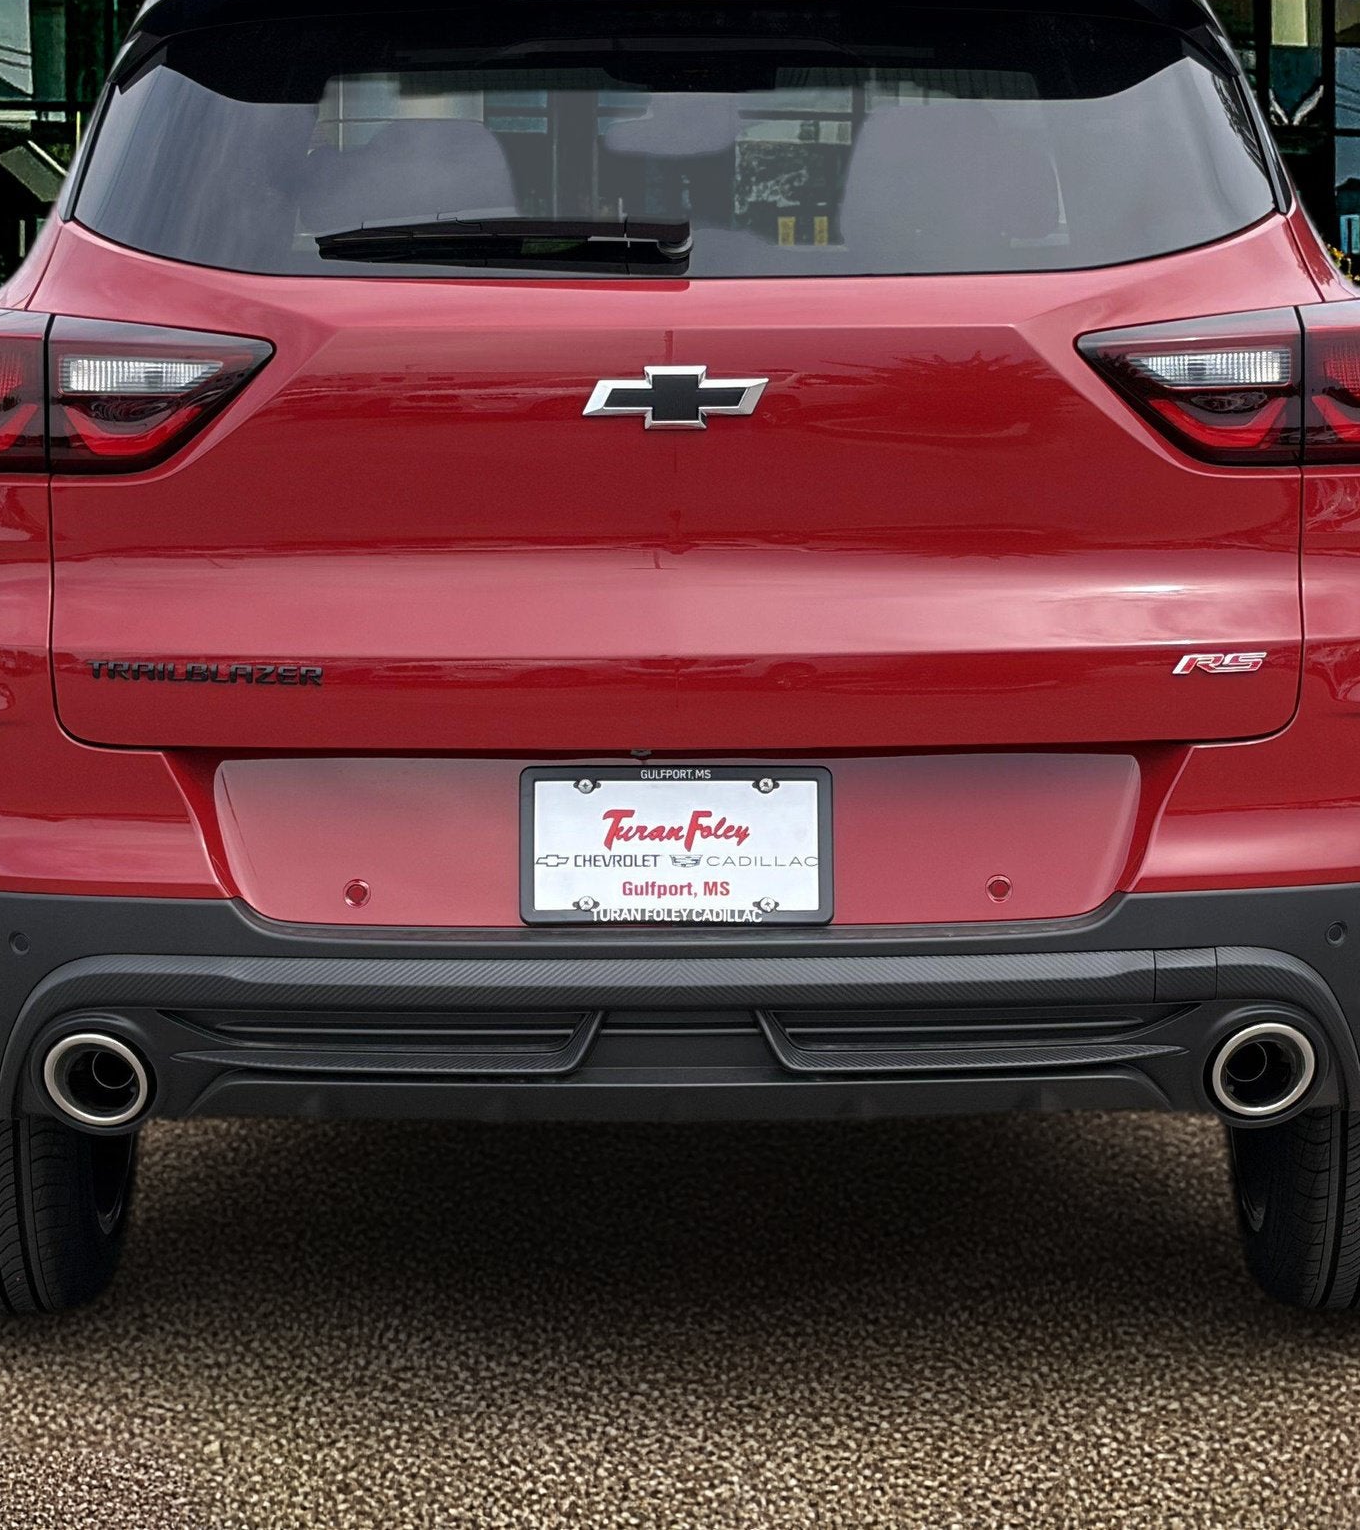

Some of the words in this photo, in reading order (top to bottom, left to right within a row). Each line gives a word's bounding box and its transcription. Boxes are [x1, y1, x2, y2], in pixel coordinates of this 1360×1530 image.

[1172, 652, 1267, 674] RS
[87, 660, 323, 686] TRAILBLAZER
[696, 769, 711, 779] MS
[603, 809, 684, 851] Turan
[684, 810, 750, 852] Foley
[574, 855, 660, 868] CHEVROLET
[706, 856, 819, 867] CADILLAC
[622, 881, 698, 898] Gulfport,
[703, 882, 730, 896] MS
[592, 909, 643, 922] TURAN
[645, 909, 692, 922] FOLEY
[692, 910, 763, 923] CADILLAC
